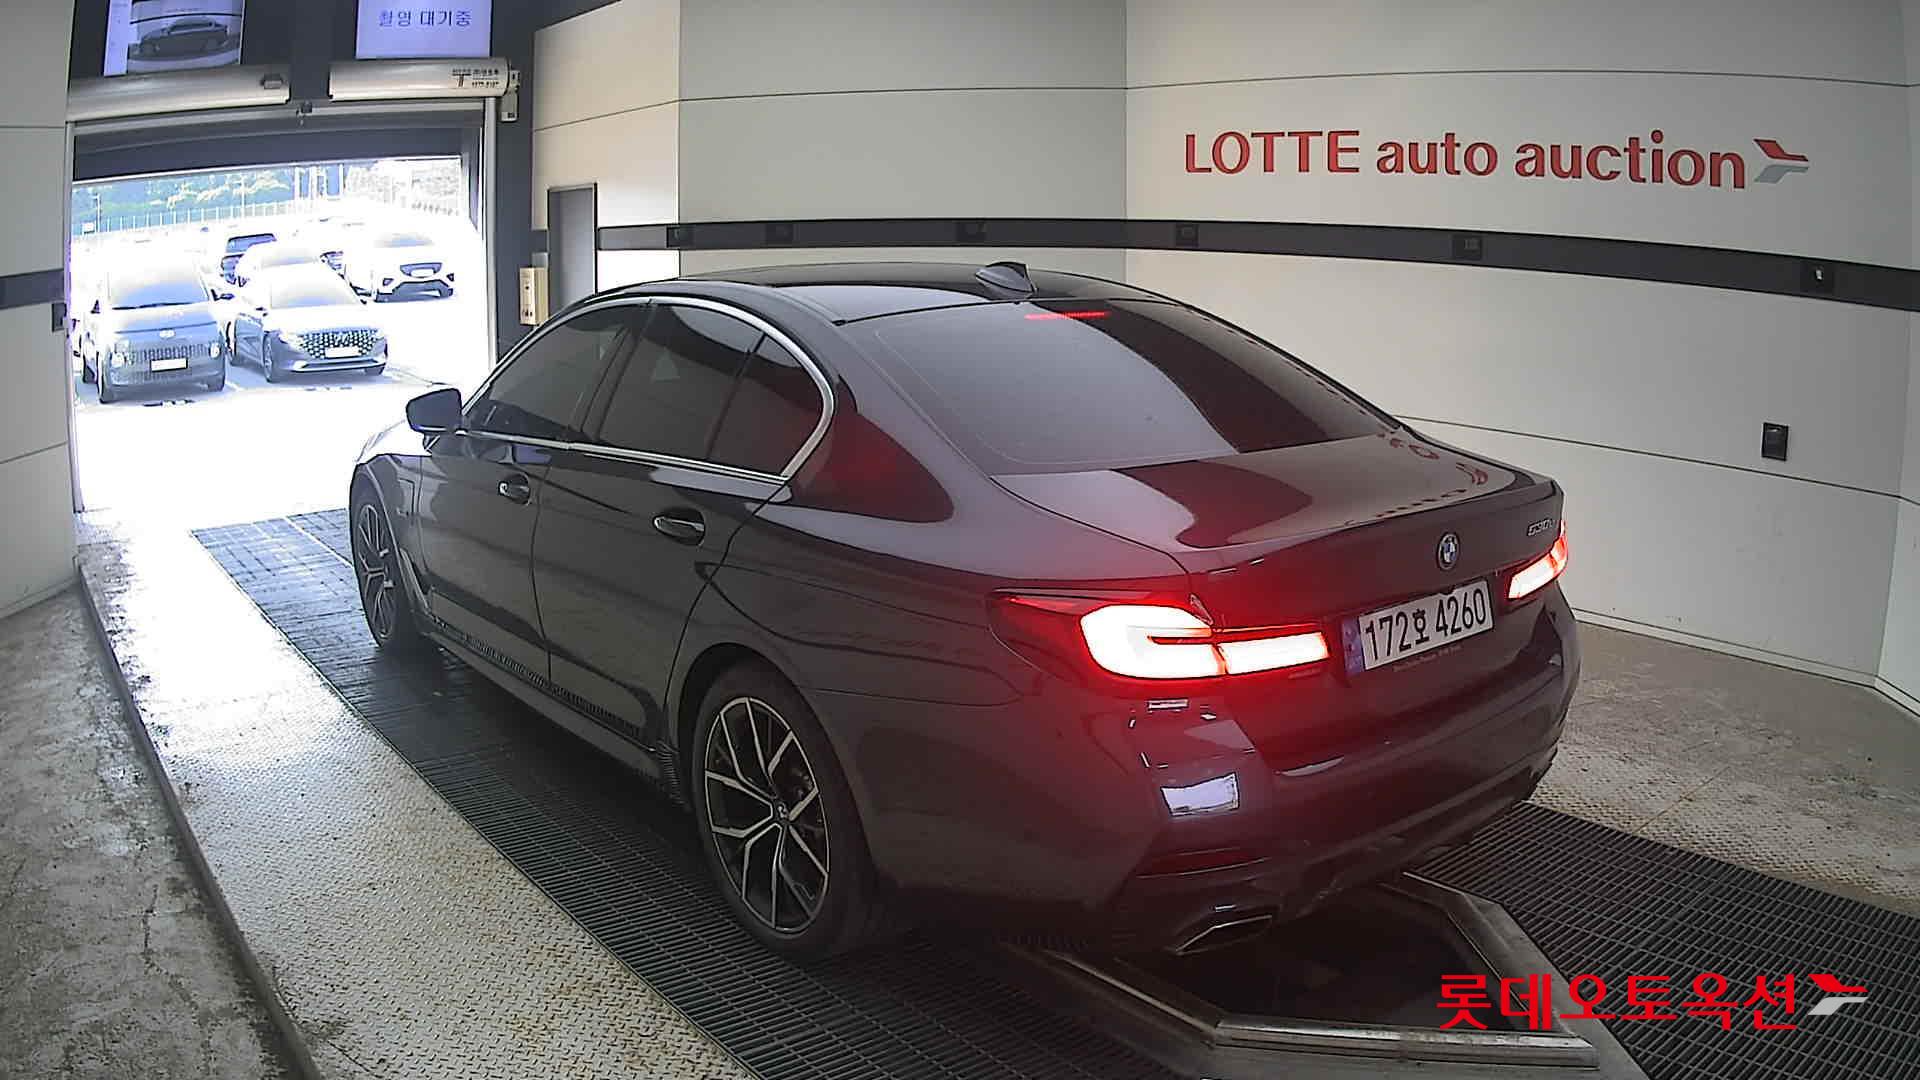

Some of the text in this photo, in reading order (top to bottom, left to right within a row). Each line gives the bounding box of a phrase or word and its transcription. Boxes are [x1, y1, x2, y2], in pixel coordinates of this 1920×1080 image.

[420, 10, 472, 27] 대기중
[1185, 130, 1746, 189] LOTTE auto auction
[1365, 607, 1430, 661] 172호
[1435, 588, 1487, 637] 4260
